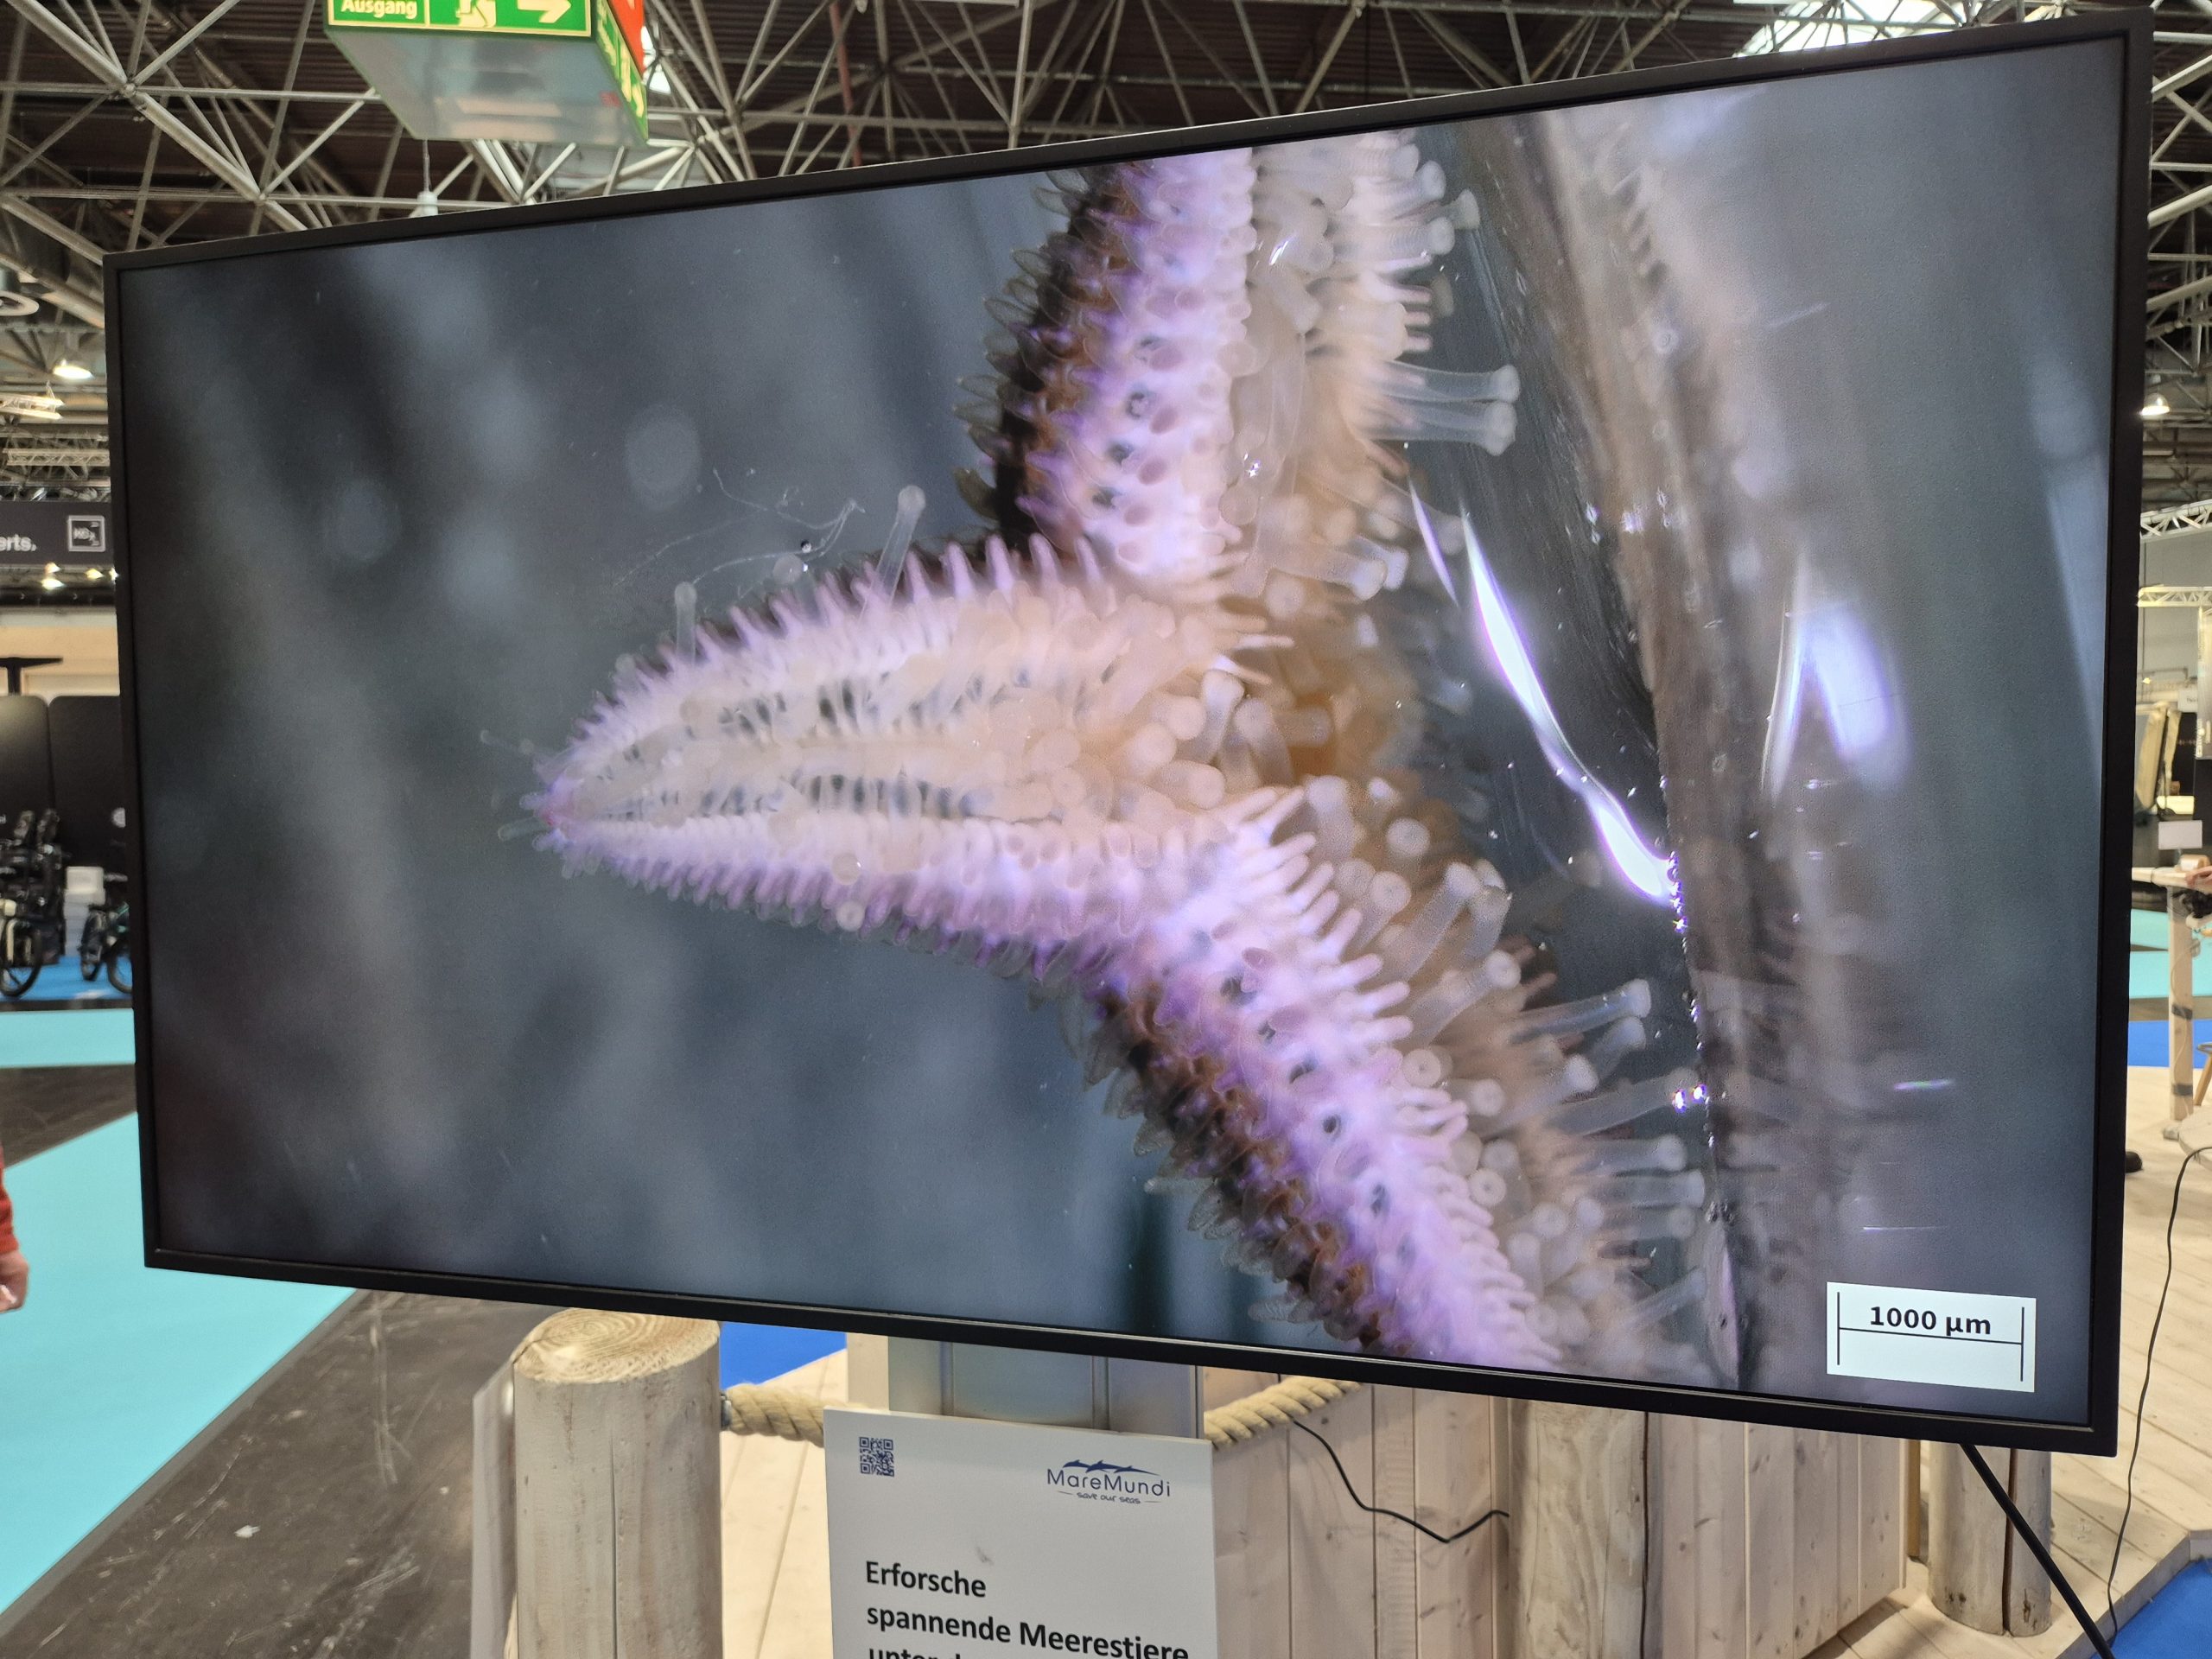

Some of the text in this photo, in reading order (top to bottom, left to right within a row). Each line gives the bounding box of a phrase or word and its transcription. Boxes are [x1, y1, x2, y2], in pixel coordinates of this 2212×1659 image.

[341, 0, 417, 19] Ausgang
[1871, 1306, 1991, 1336] 1000 µm
[1047, 1469, 1170, 1497] MareMundi
[1077, 1491, 1097, 1500] save
[867, 1560, 986, 1598] Erforsche
[867, 1607, 1189, 1659] spannende Meerestiere
